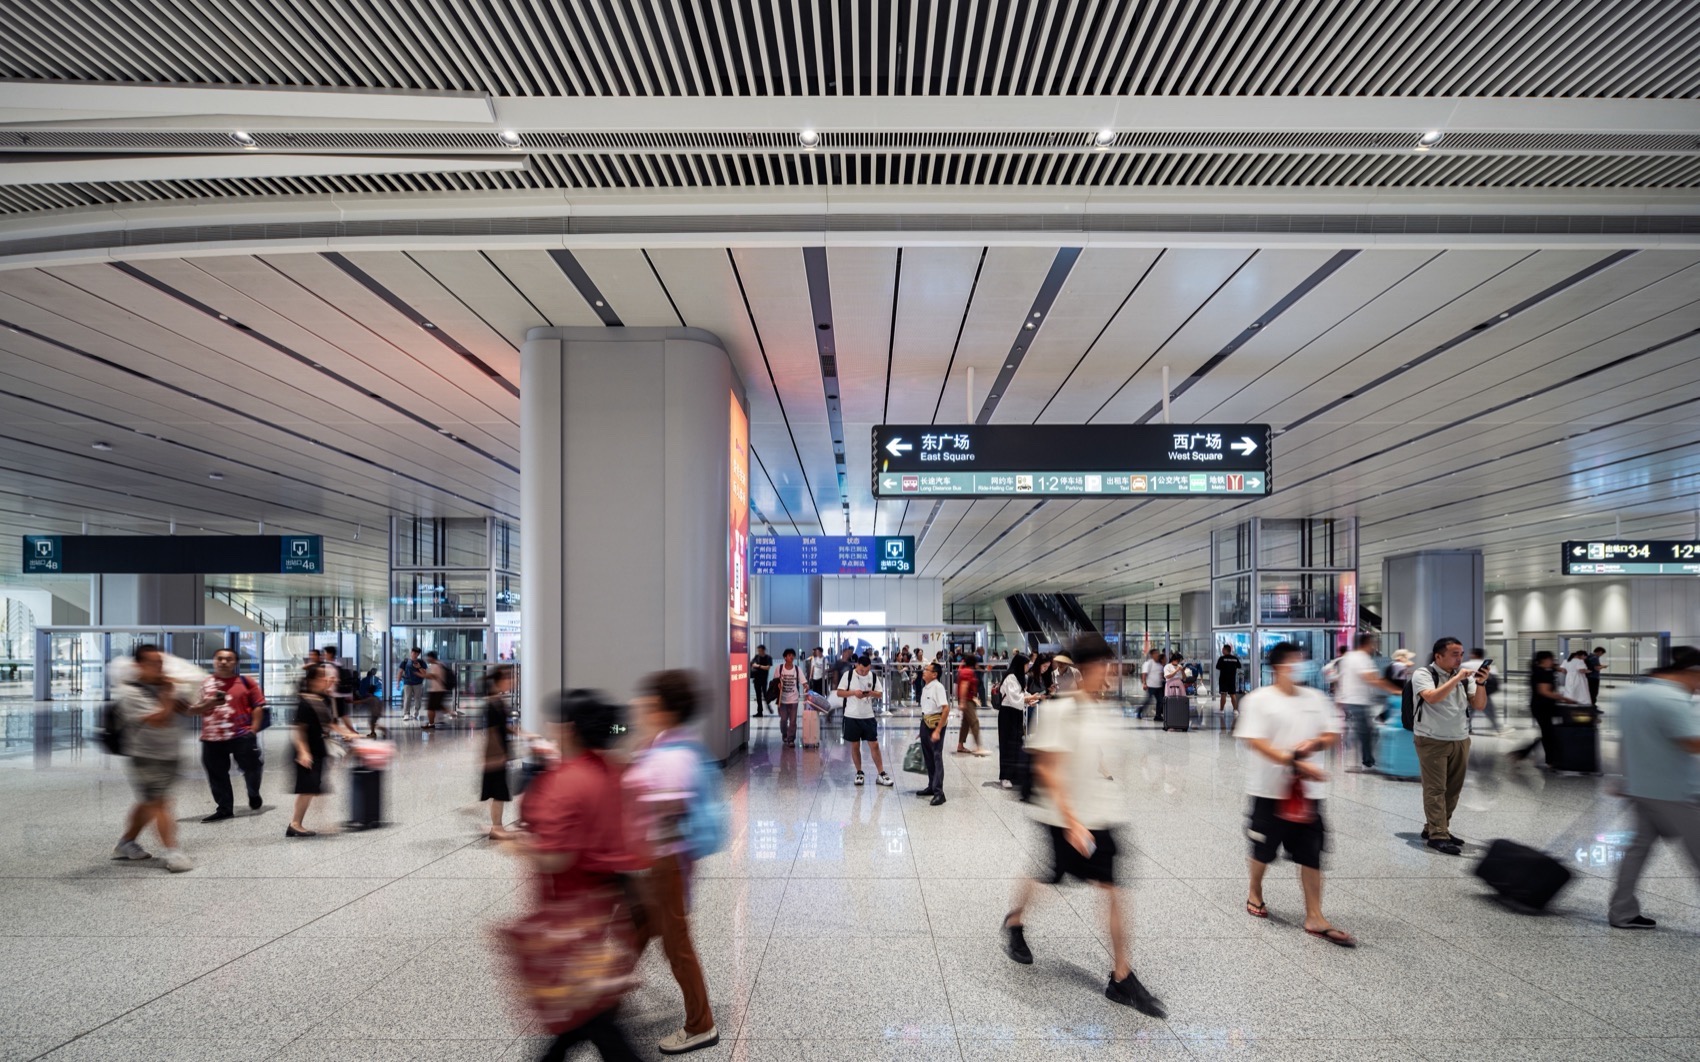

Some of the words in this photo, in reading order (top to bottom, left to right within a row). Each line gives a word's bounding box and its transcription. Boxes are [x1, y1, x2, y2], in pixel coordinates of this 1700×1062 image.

[921, 434, 970, 451] 东广场
[1173, 433, 1222, 450] 西广场
[920, 452, 941, 461] East
[943, 452, 975, 462] Square
[1168, 452, 1190, 460] West
[1192, 452, 1223, 462] Square
[921, 477, 951, 485] 长途汽车
[991, 477, 1014, 485] 网约车
[1060, 477, 1083, 485] 停车场
[1107, 477, 1129, 485] 出租车
[1158, 476, 1188, 484] 公交汽车
[1209, 476, 1225, 484] 地铁
[1605, 544, 1628, 553] 出站口
[46, 560, 58, 569] 4B
[302, 560, 315, 570] 4B
[897, 560, 909, 570] 3B
[930, 632, 941, 641] 17
